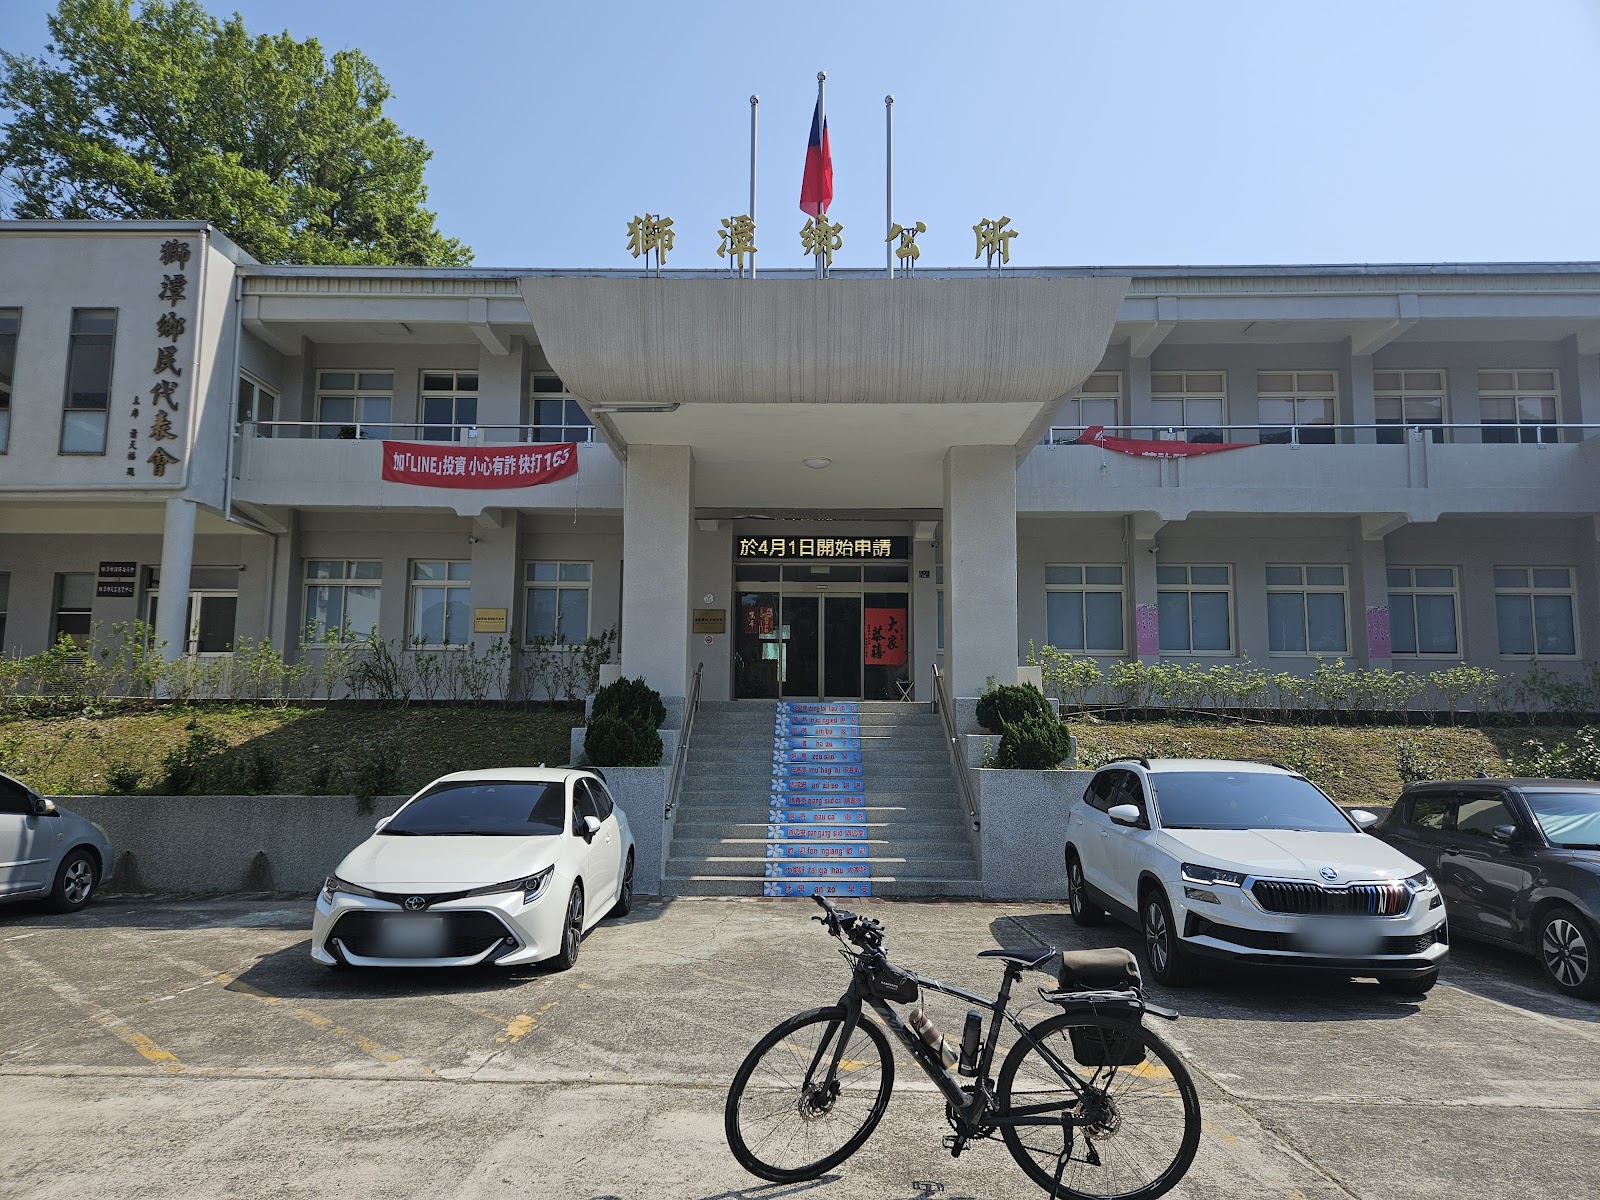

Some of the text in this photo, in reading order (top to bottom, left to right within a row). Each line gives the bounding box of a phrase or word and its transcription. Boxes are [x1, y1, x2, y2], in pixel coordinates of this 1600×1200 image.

[626, 213, 1019, 267] 獅潭鄉公所
[147, 238, 191, 477] 獅潭鄉民代表會
[393, 451, 466, 476] 加「LINE」投資
[469, 454, 516, 476] 小心有詐
[740, 538, 892, 557] 於4月1日開始申請
